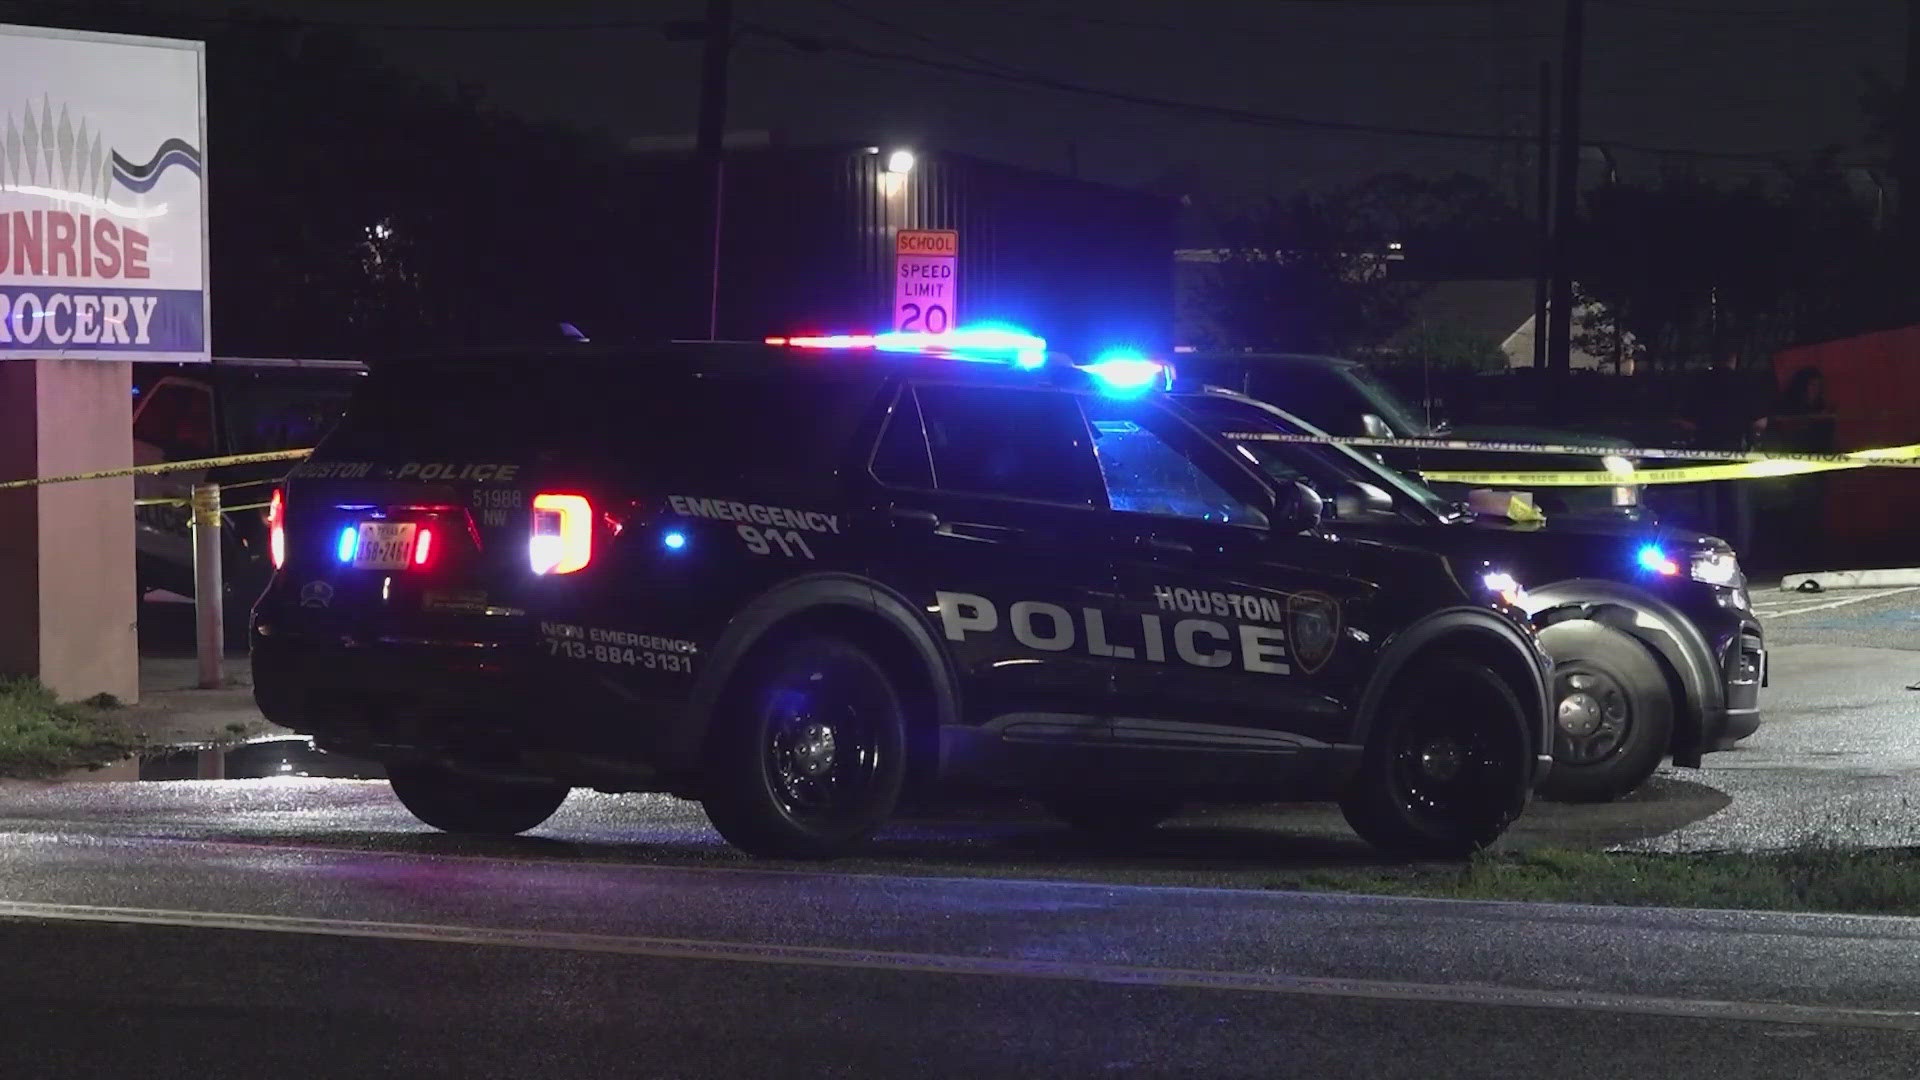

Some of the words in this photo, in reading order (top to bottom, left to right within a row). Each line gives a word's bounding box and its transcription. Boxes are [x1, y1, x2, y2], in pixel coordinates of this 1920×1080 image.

[901, 236, 953, 251] SCHOOL
[901, 264, 951, 278] SPEED
[905, 282, 944, 297] LIMIT
[901, 303, 947, 334] 20
[396, 463, 520, 481] POLICE
[472, 488, 522, 508] 51988
[483, 509, 508, 527] NW
[668, 495, 840, 534] EMERGENCY
[737, 524, 816, 560] 911
[1154, 584, 1281, 623] HOUSTON
[540, 621, 584, 640] NON
[590, 627, 698, 654] EMERGENCY
[935, 590, 1291, 676] POLICE
[545, 638, 693, 674] 713-884-3131
